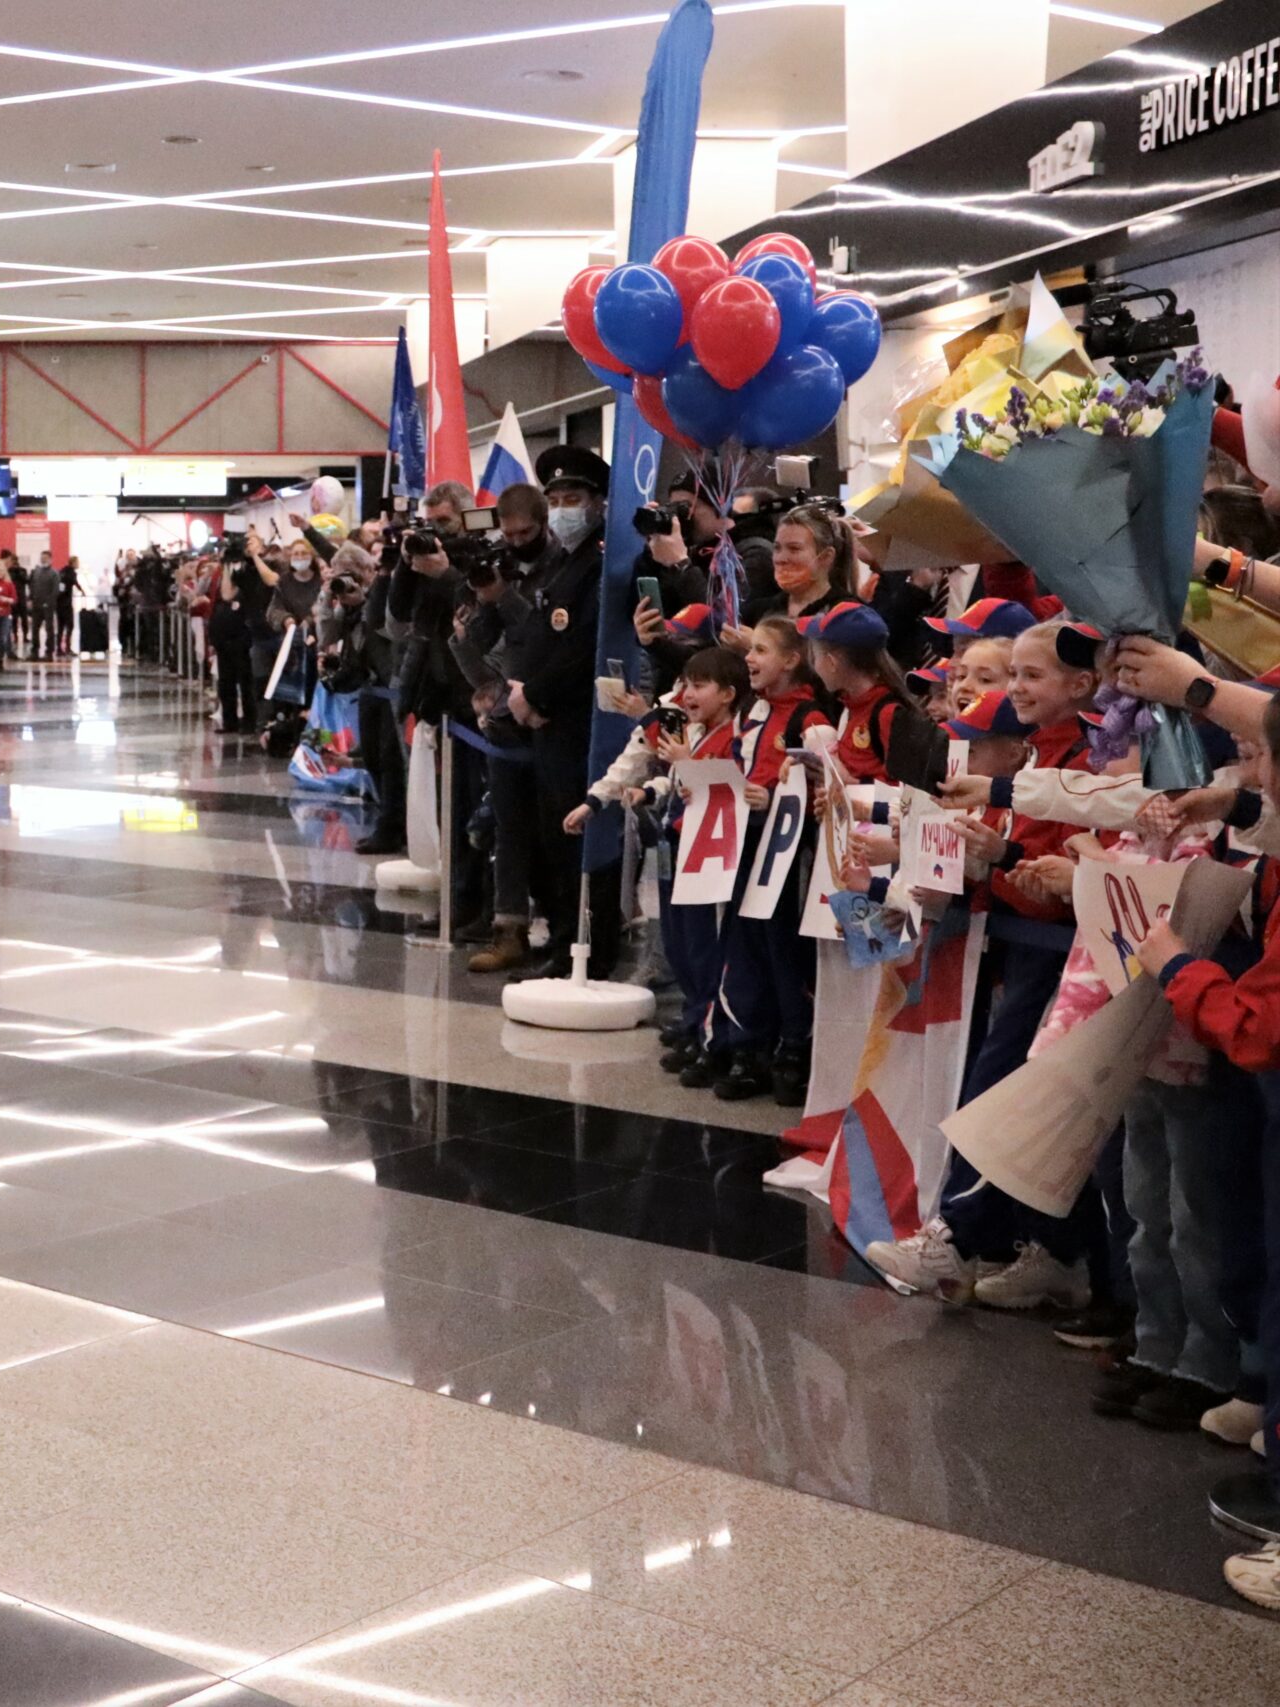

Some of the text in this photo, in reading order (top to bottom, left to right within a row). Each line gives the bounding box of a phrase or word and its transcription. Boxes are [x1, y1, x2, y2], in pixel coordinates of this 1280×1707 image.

[1138, 37, 1280, 152] ONE PRICE COFFE
